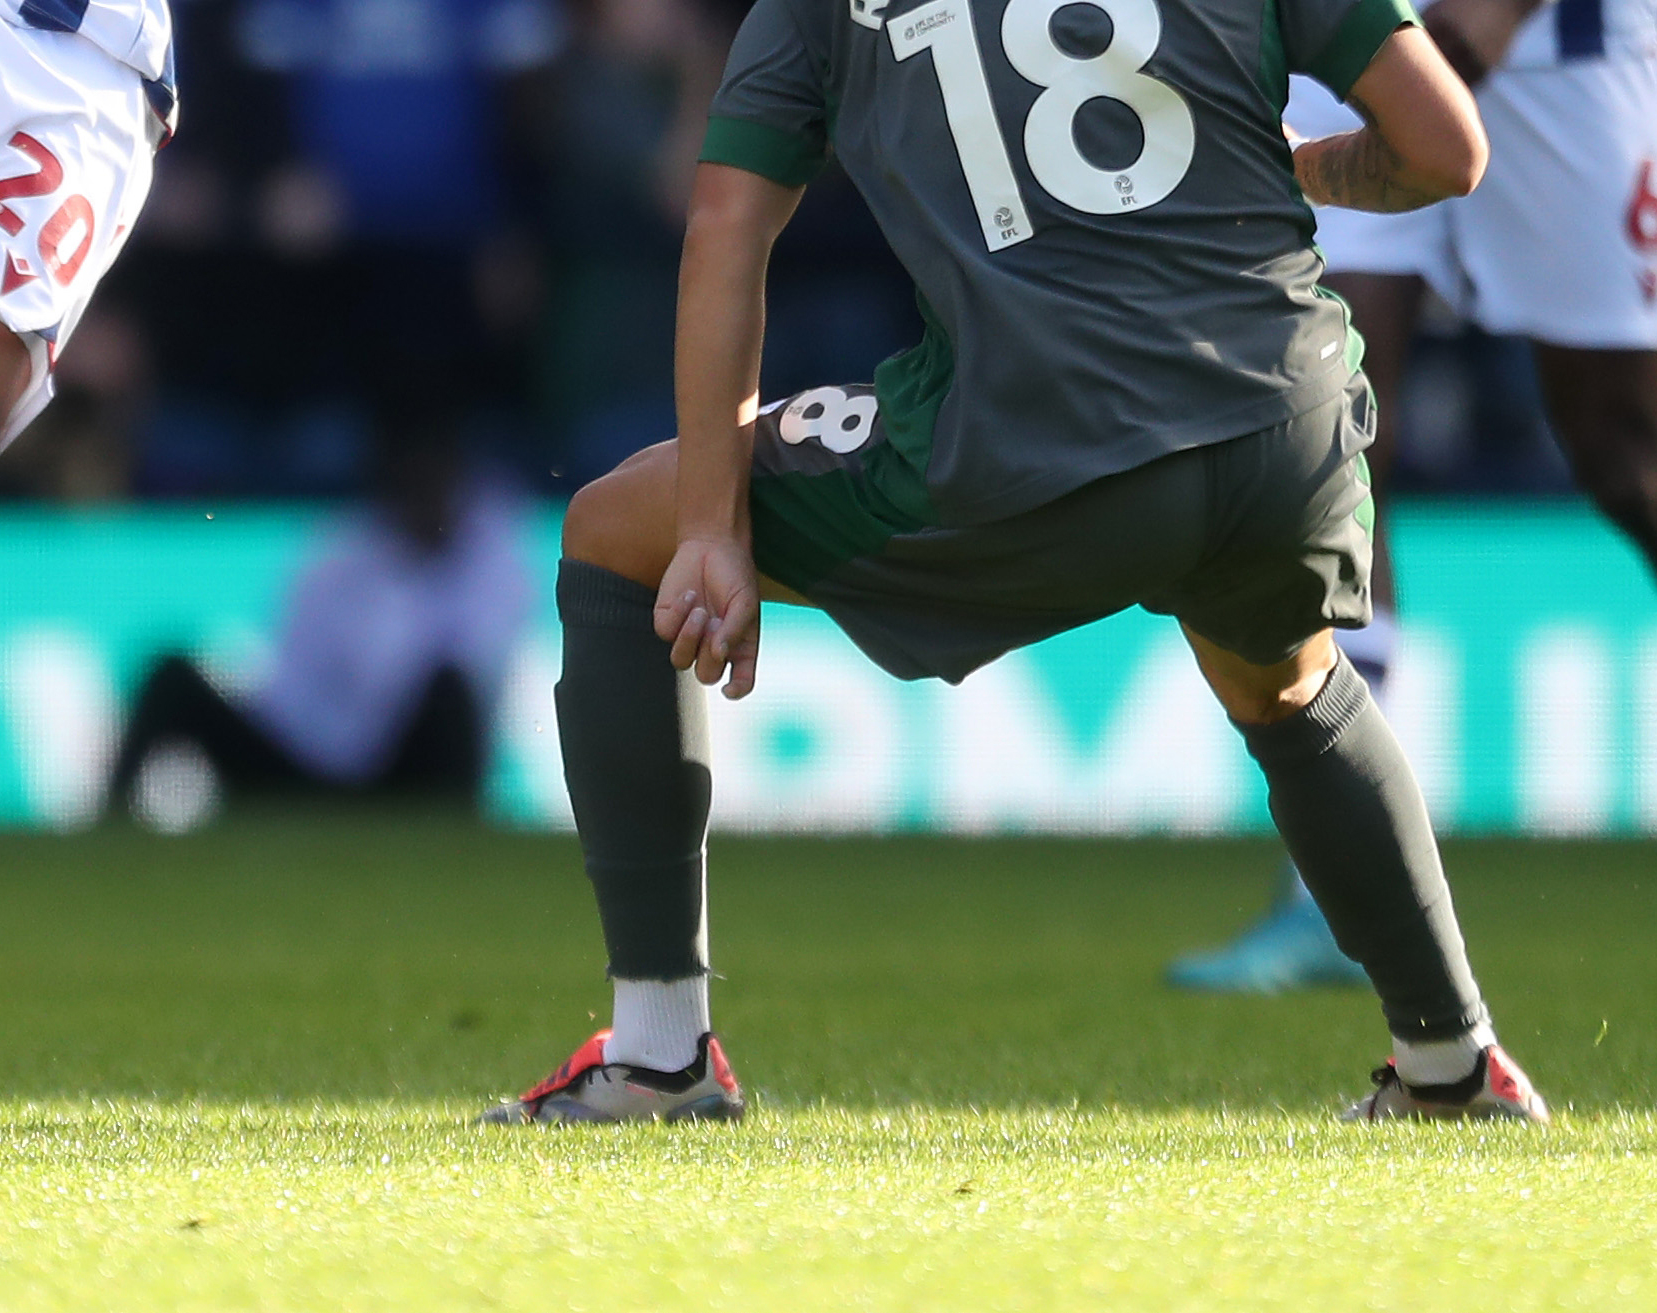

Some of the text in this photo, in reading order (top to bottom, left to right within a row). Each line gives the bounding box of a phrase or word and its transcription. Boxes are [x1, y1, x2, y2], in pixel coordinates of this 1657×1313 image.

[1121, 195, 1138, 206] EFL
[1000, 228, 1019, 240] EFL
[779, 386, 879, 455] 8
